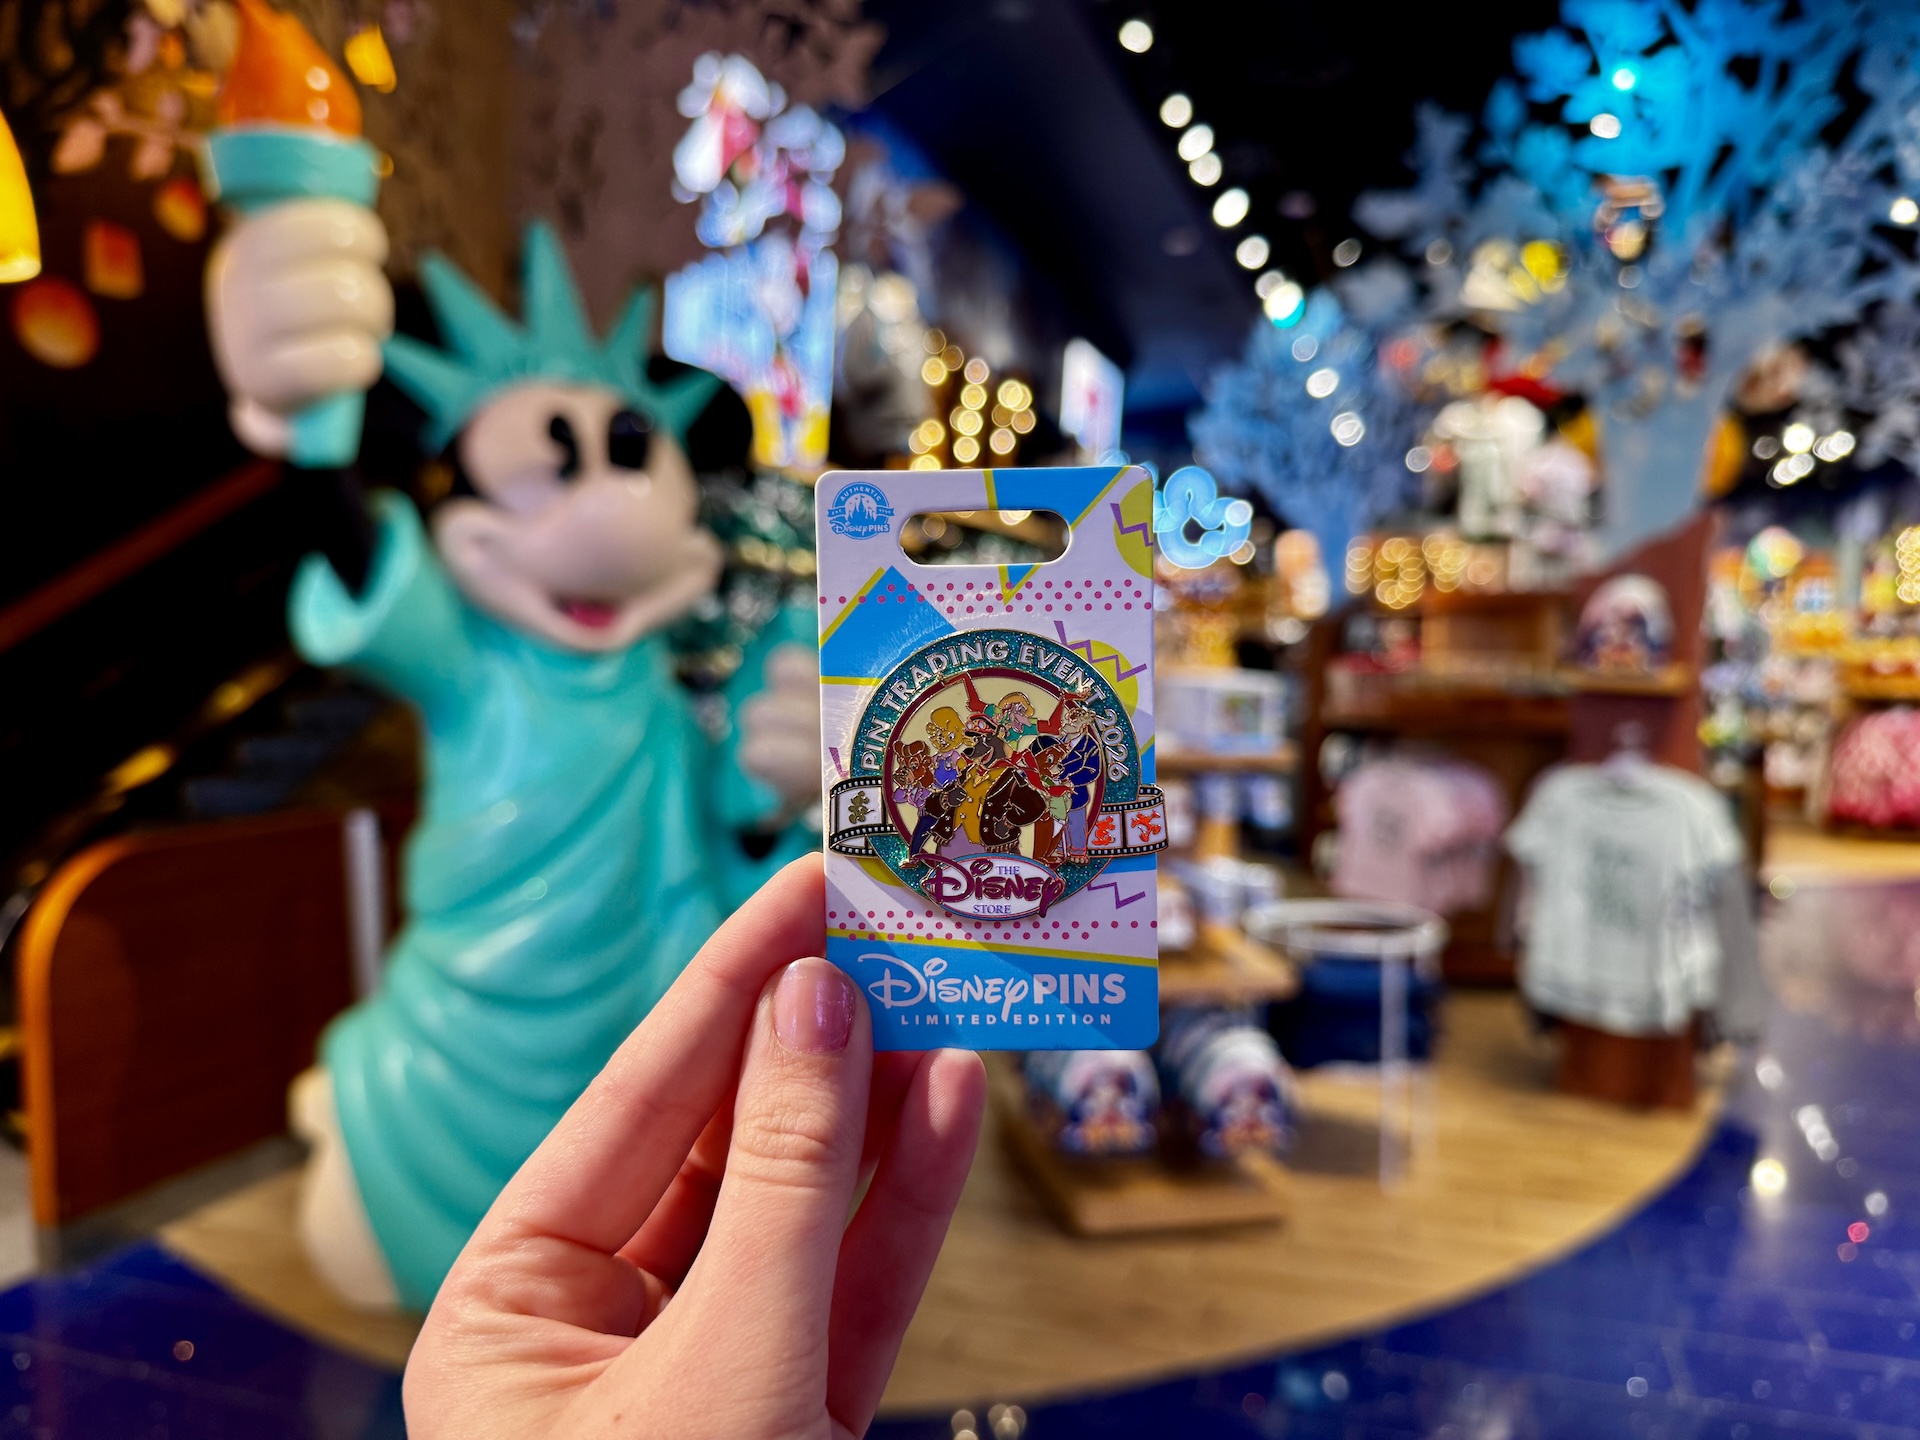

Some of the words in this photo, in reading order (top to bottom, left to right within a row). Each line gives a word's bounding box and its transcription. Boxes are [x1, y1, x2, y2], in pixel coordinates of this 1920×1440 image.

[840, 486, 881, 501] AUTHENTIC
[868, 524, 889, 532] PINS
[860, 715, 888, 770] PIN
[881, 639, 1009, 712] TRADING
[1017, 642, 1106, 708] EVENT
[1100, 708, 1131, 783] 2026
[996, 865, 1020, 876] THE
[973, 904, 1011, 914] STORE
[1033, 973, 1127, 1004] PINS
[901, 1014, 997, 1025] LIMITED
[1013, 1014, 1112, 1025] EDITION
